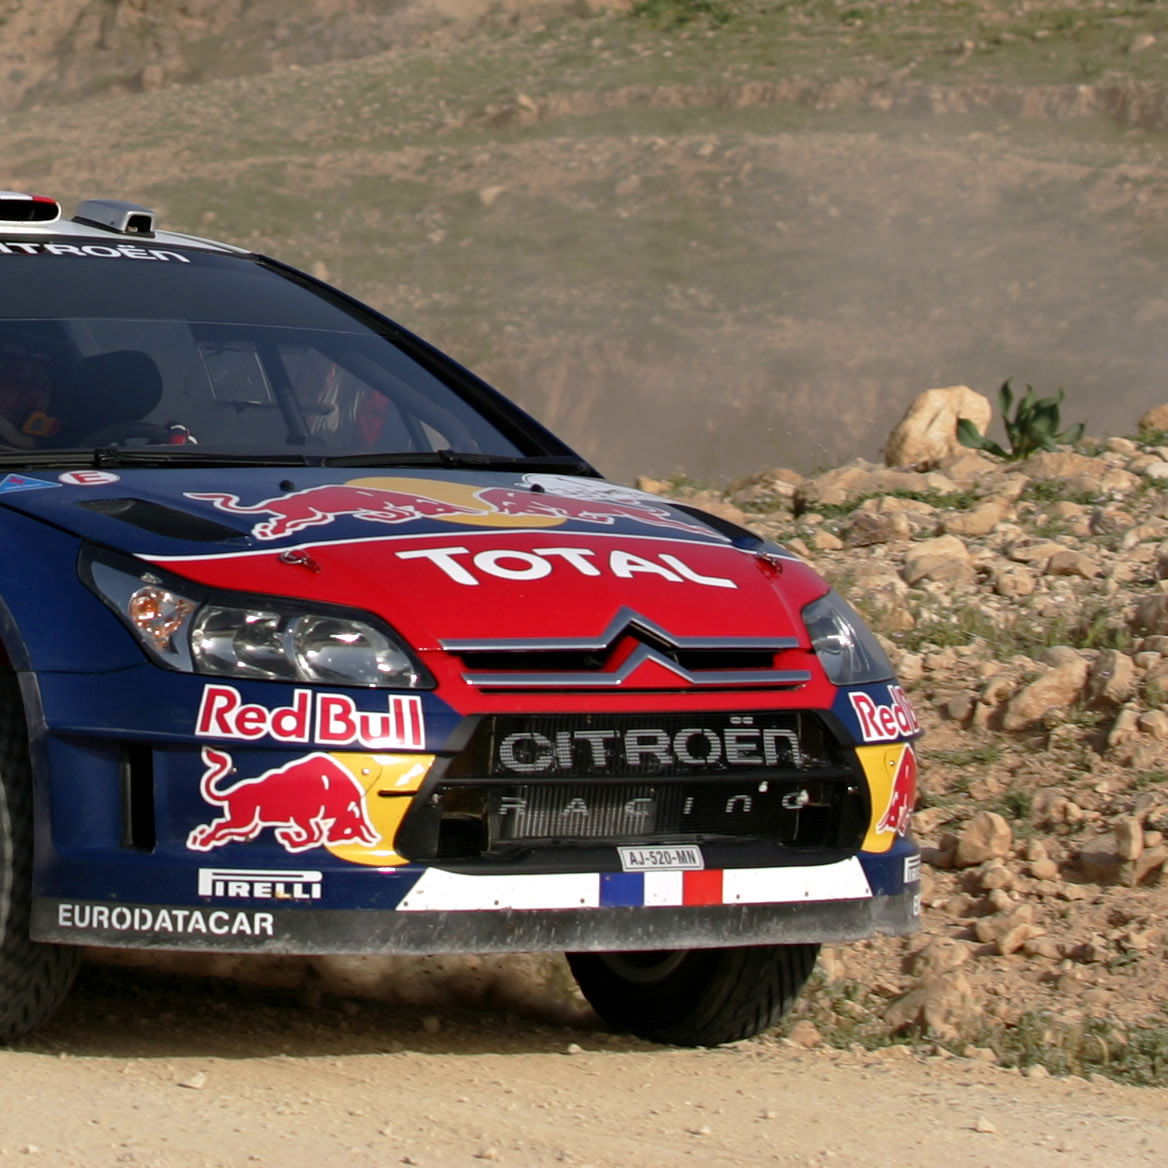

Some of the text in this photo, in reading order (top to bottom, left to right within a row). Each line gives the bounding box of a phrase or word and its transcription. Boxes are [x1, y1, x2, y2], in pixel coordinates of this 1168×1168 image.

[69, 470, 111, 485] E
[394, 545, 739, 589] TOTAL
[498, 715, 804, 773] CITROËN
[629, 850, 698, 867] AJ-520-MN
[197, 867, 324, 900] PIRELLI
[57, 903, 275, 936] EURODATACAR
